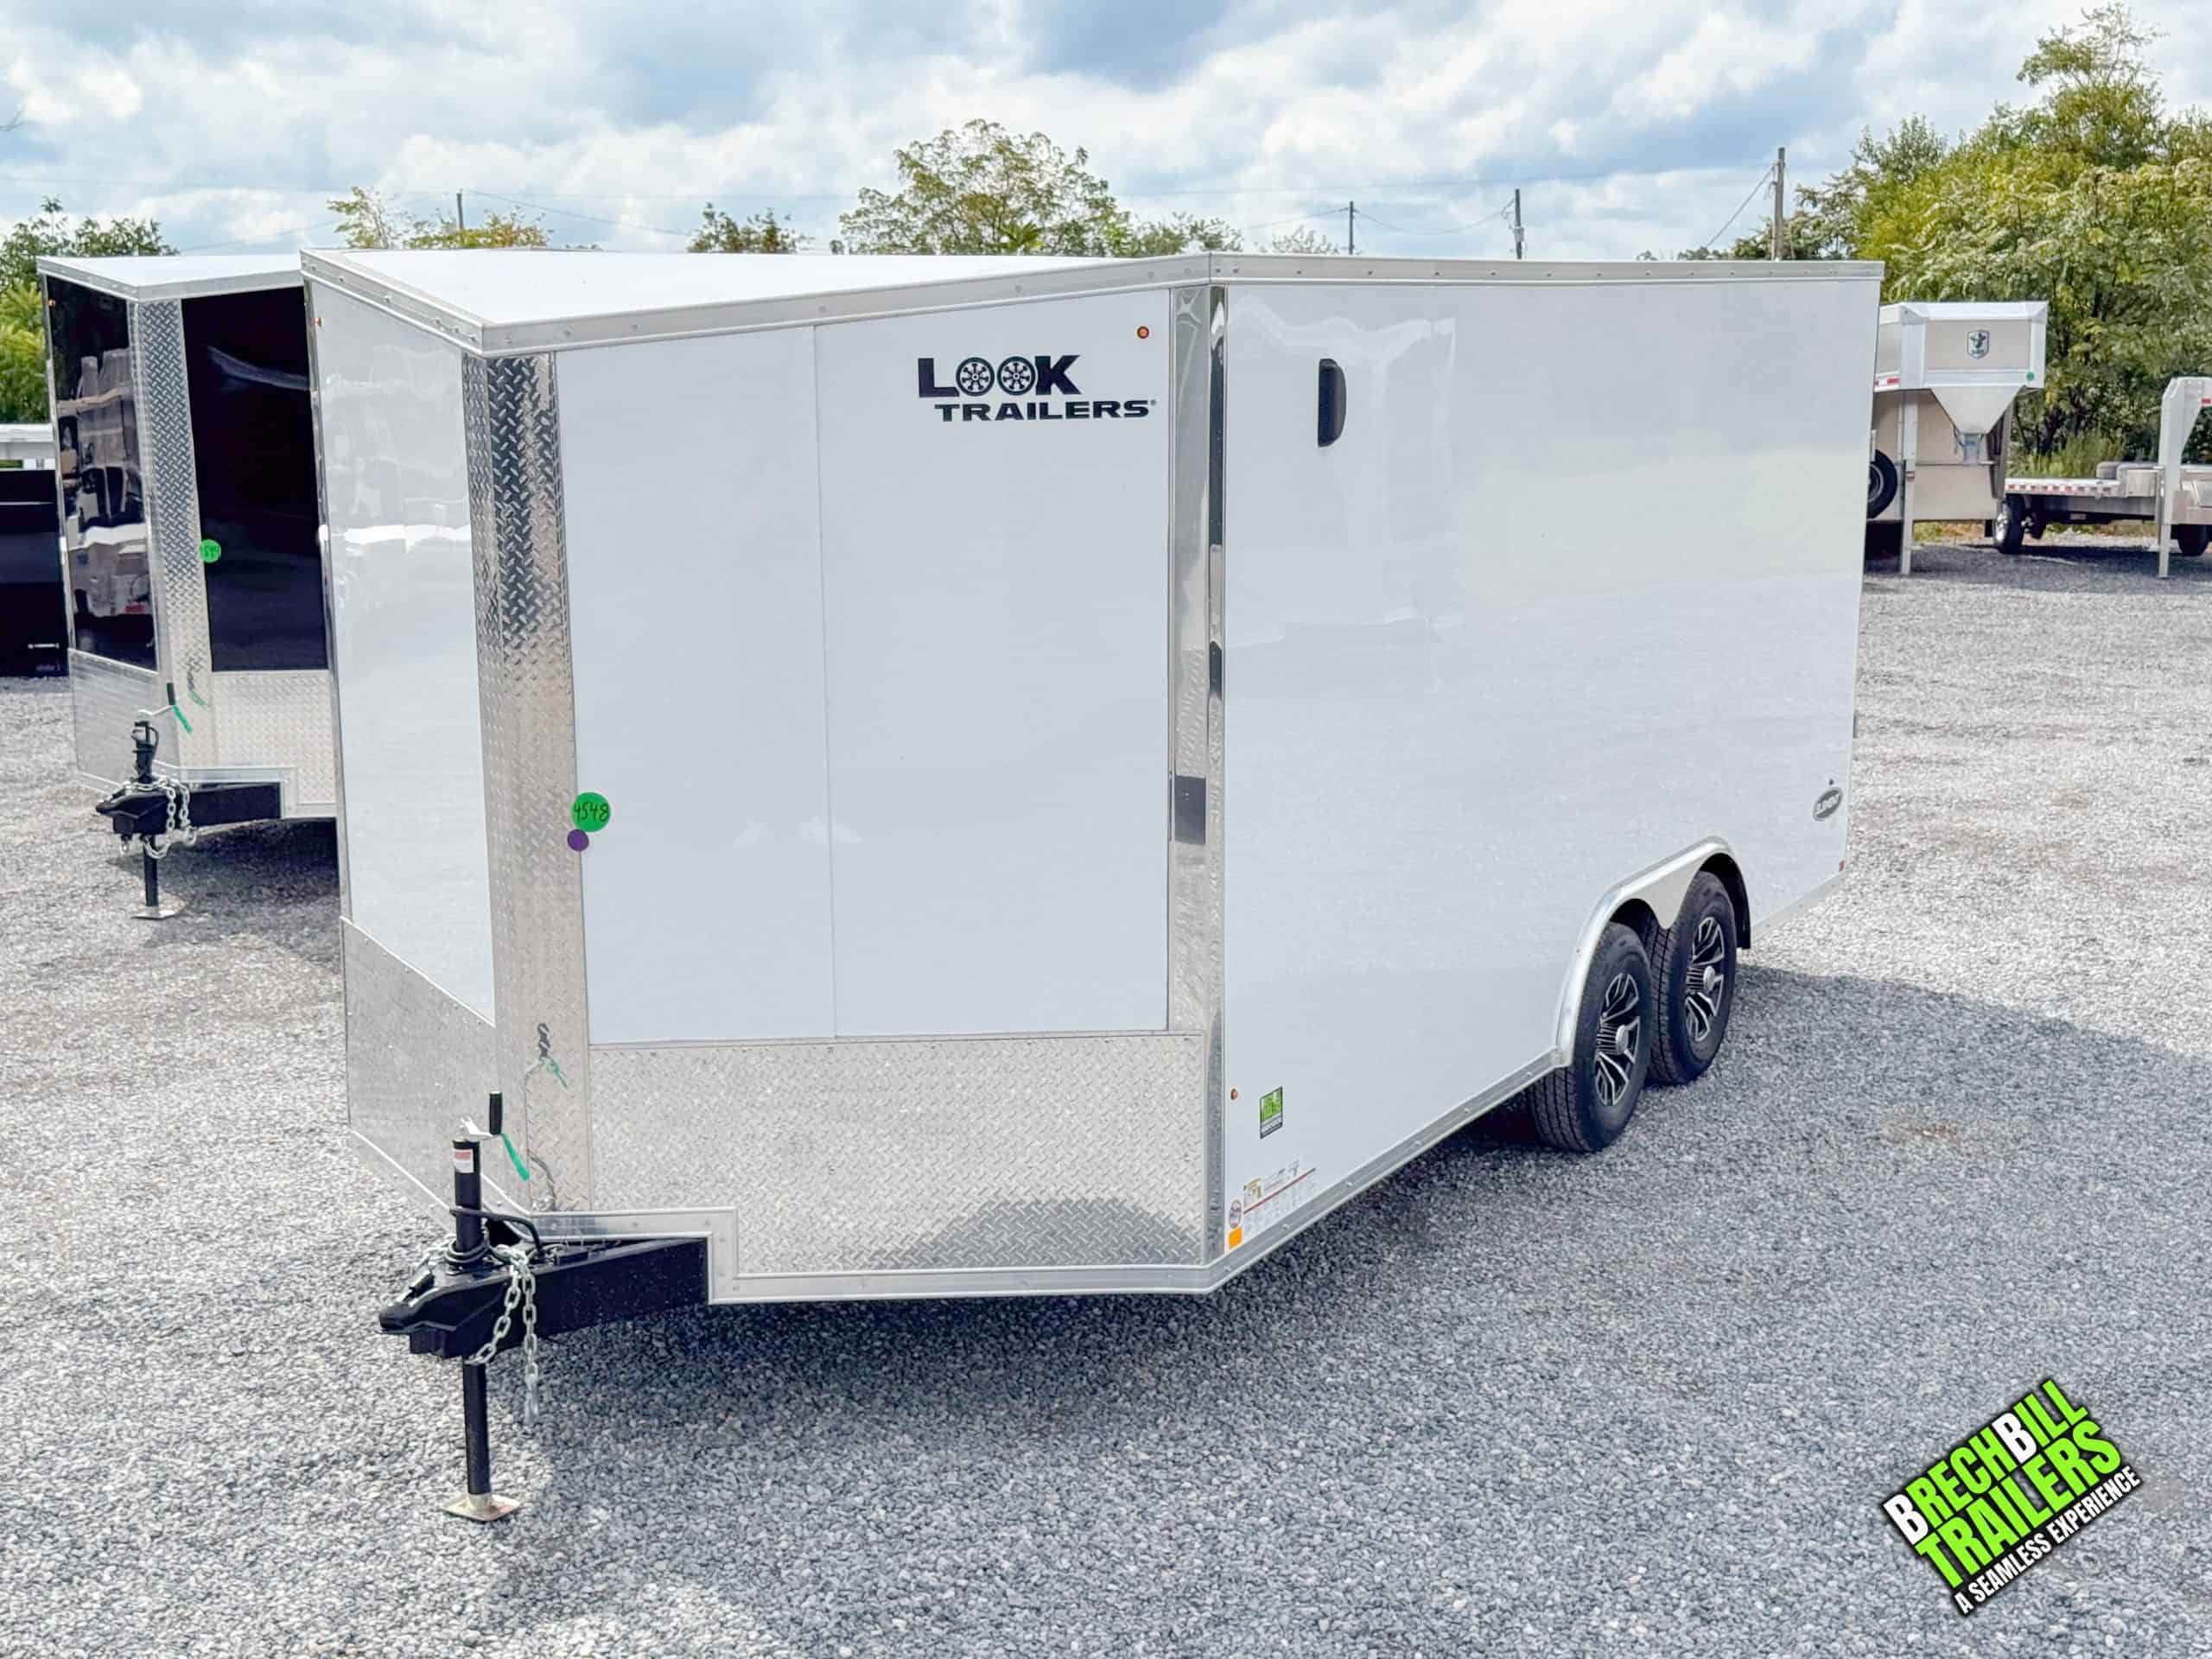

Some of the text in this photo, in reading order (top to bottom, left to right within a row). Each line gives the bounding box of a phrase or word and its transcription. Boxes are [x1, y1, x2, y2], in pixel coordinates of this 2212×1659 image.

[918, 355, 1082, 397] LOOK
[934, 400, 1150, 422] TRAILERS
[574, 802, 609, 823] 4548
